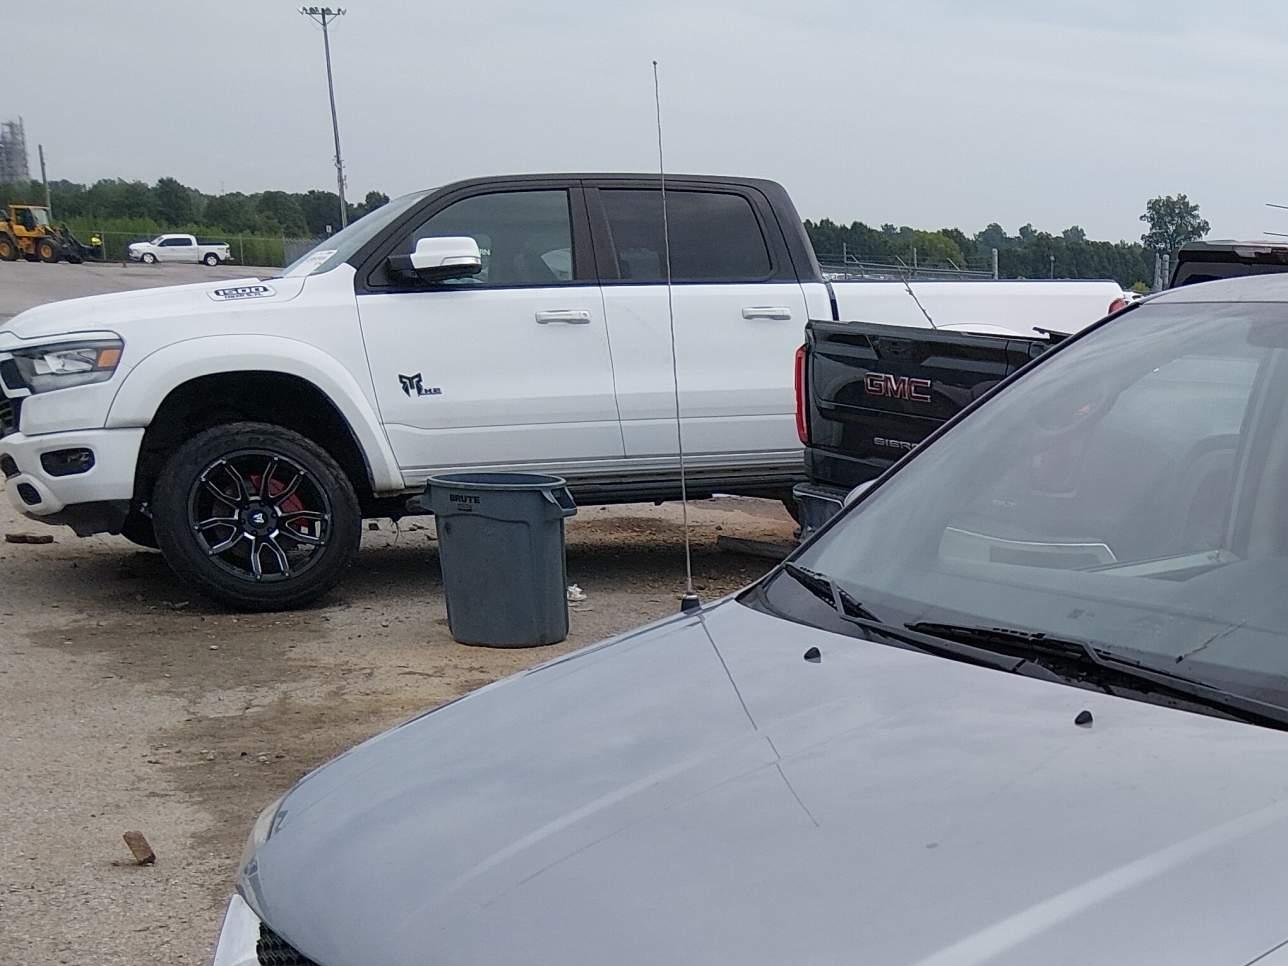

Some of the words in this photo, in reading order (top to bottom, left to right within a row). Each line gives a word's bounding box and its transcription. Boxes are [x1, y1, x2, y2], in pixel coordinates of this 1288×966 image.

[216, 286, 265, 297] 1500
[864, 371, 931, 402] GMC
[449, 494, 481, 504] BRUTE
